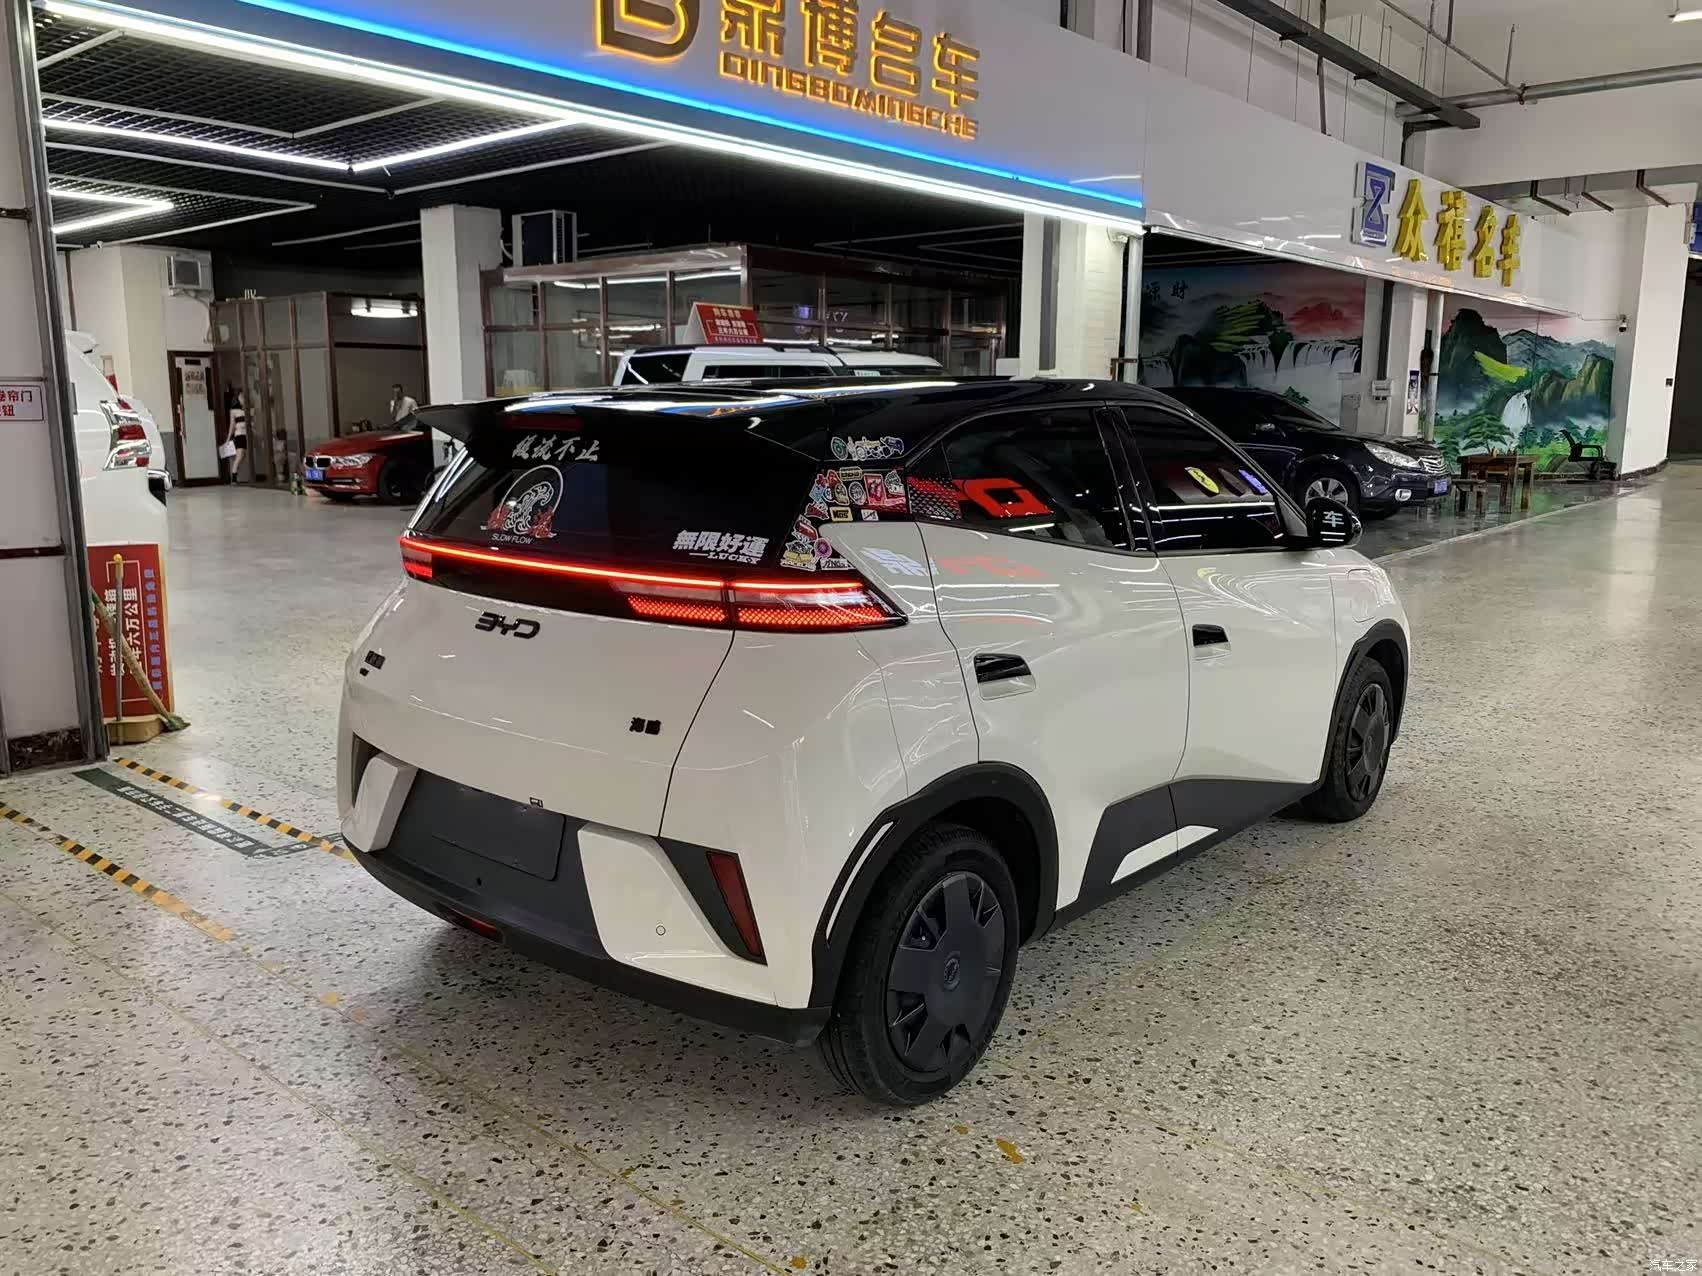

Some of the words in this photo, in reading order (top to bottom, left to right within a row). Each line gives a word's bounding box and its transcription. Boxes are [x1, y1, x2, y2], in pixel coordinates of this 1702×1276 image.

[491, 533, 511, 542] SLOW
[511, 535, 533, 544] FLOW
[672, 530, 770, 558] 無限好運
[475, 611, 541, 640] BYD
